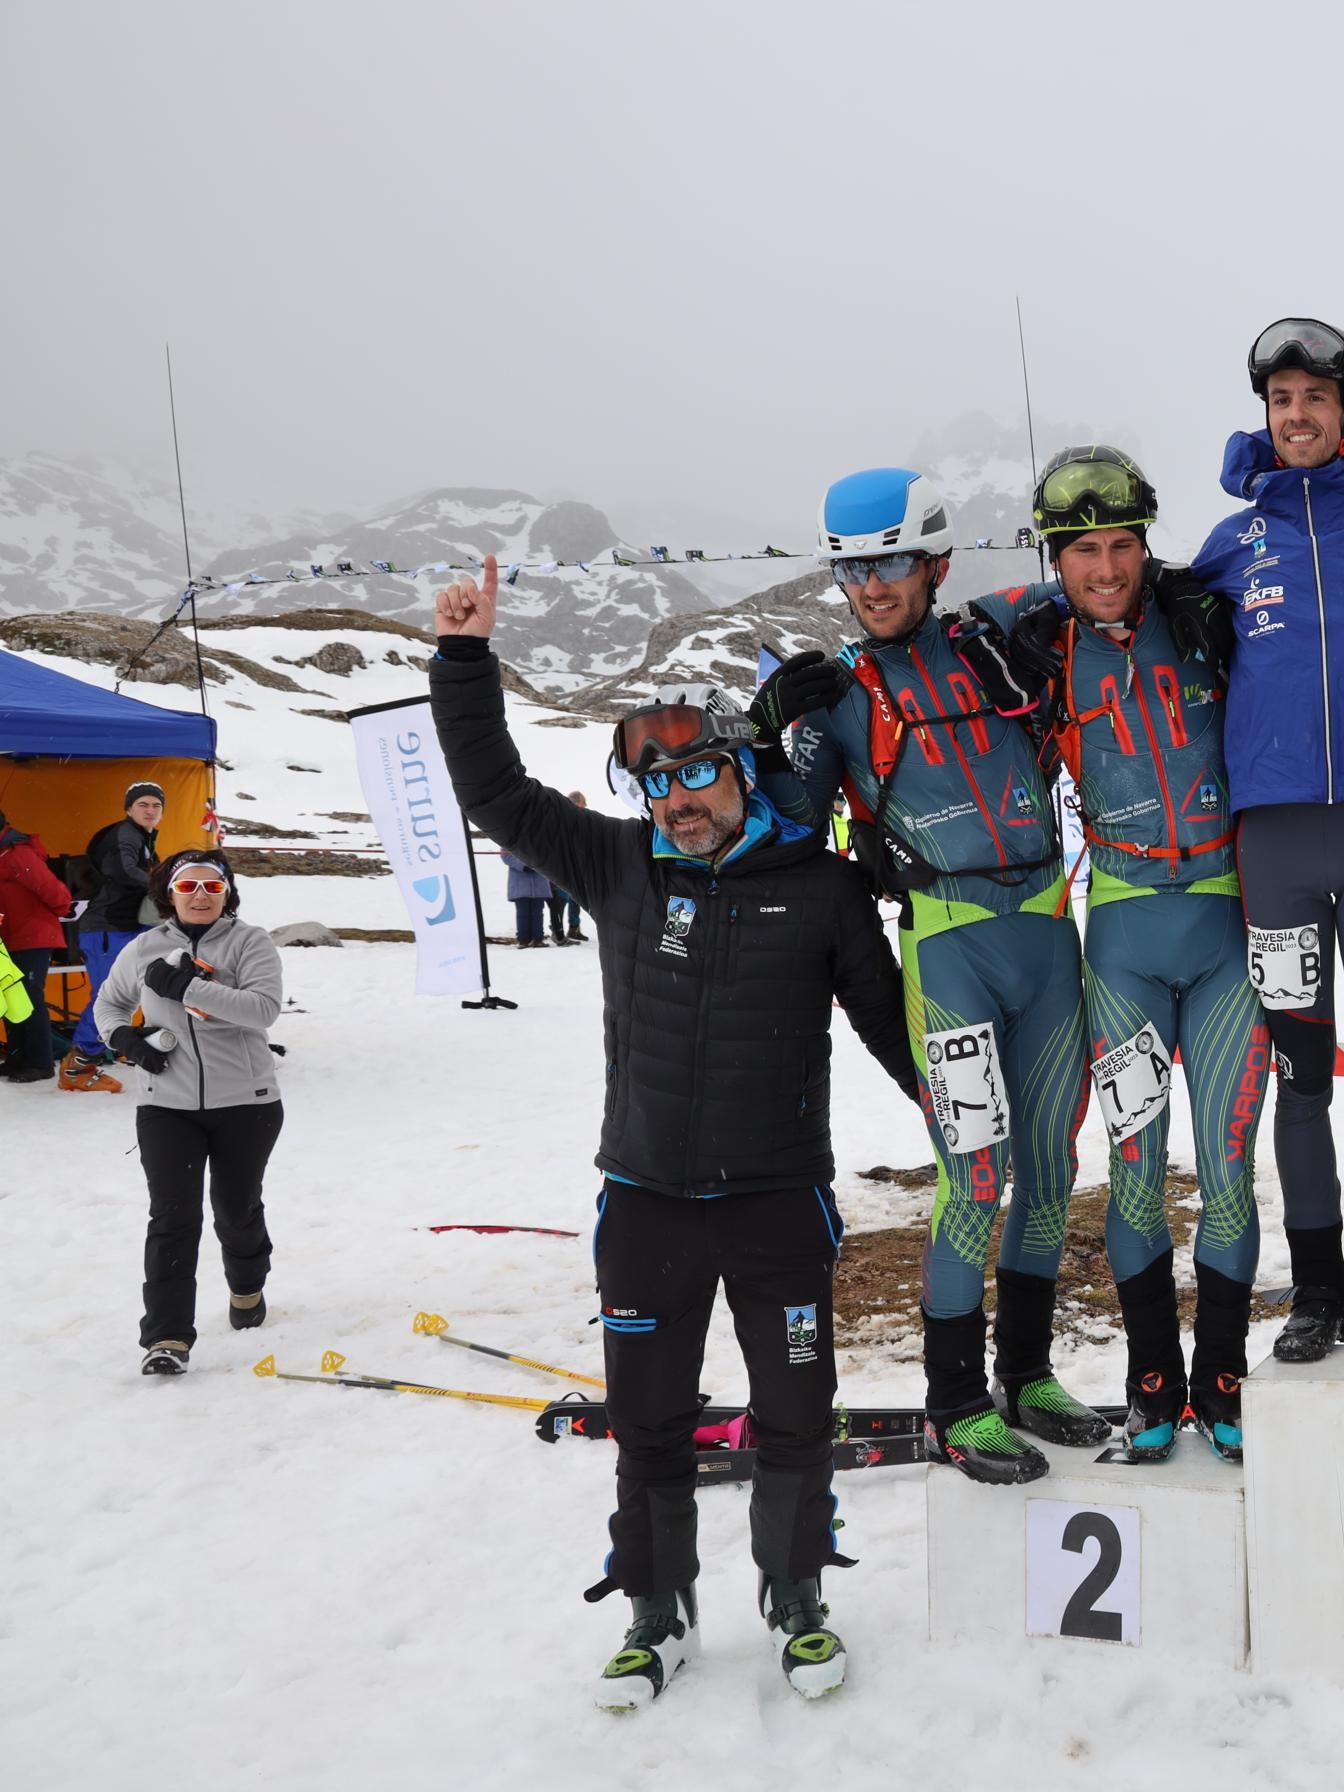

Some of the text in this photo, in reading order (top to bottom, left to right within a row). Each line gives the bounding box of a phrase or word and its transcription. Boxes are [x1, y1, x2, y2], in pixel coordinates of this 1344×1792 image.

[1245, 585, 1284, 606] EKFB
[1248, 622, 1285, 637] SCARPA
[949, 801, 974, 812] Navarra
[1133, 798, 1157, 809] Navarra
[885, 838, 913, 864] CAMP
[1256, 942, 1286, 952] REGIL
[1251, 952, 1320, 986] 5 B
[944, 1034, 987, 1120] B 7
[1104, 1061, 1131, 1080] REGIL
[1102, 1051, 1170, 1113] 7 A
[938, 1077, 951, 1112] REGIL
[1226, 1023, 1271, 1163] KARPOS
[789, 1351, 815, 1359] Mendizale
[789, 1355, 818, 1364] Federazioa
[1060, 1511, 1122, 1641] 2
